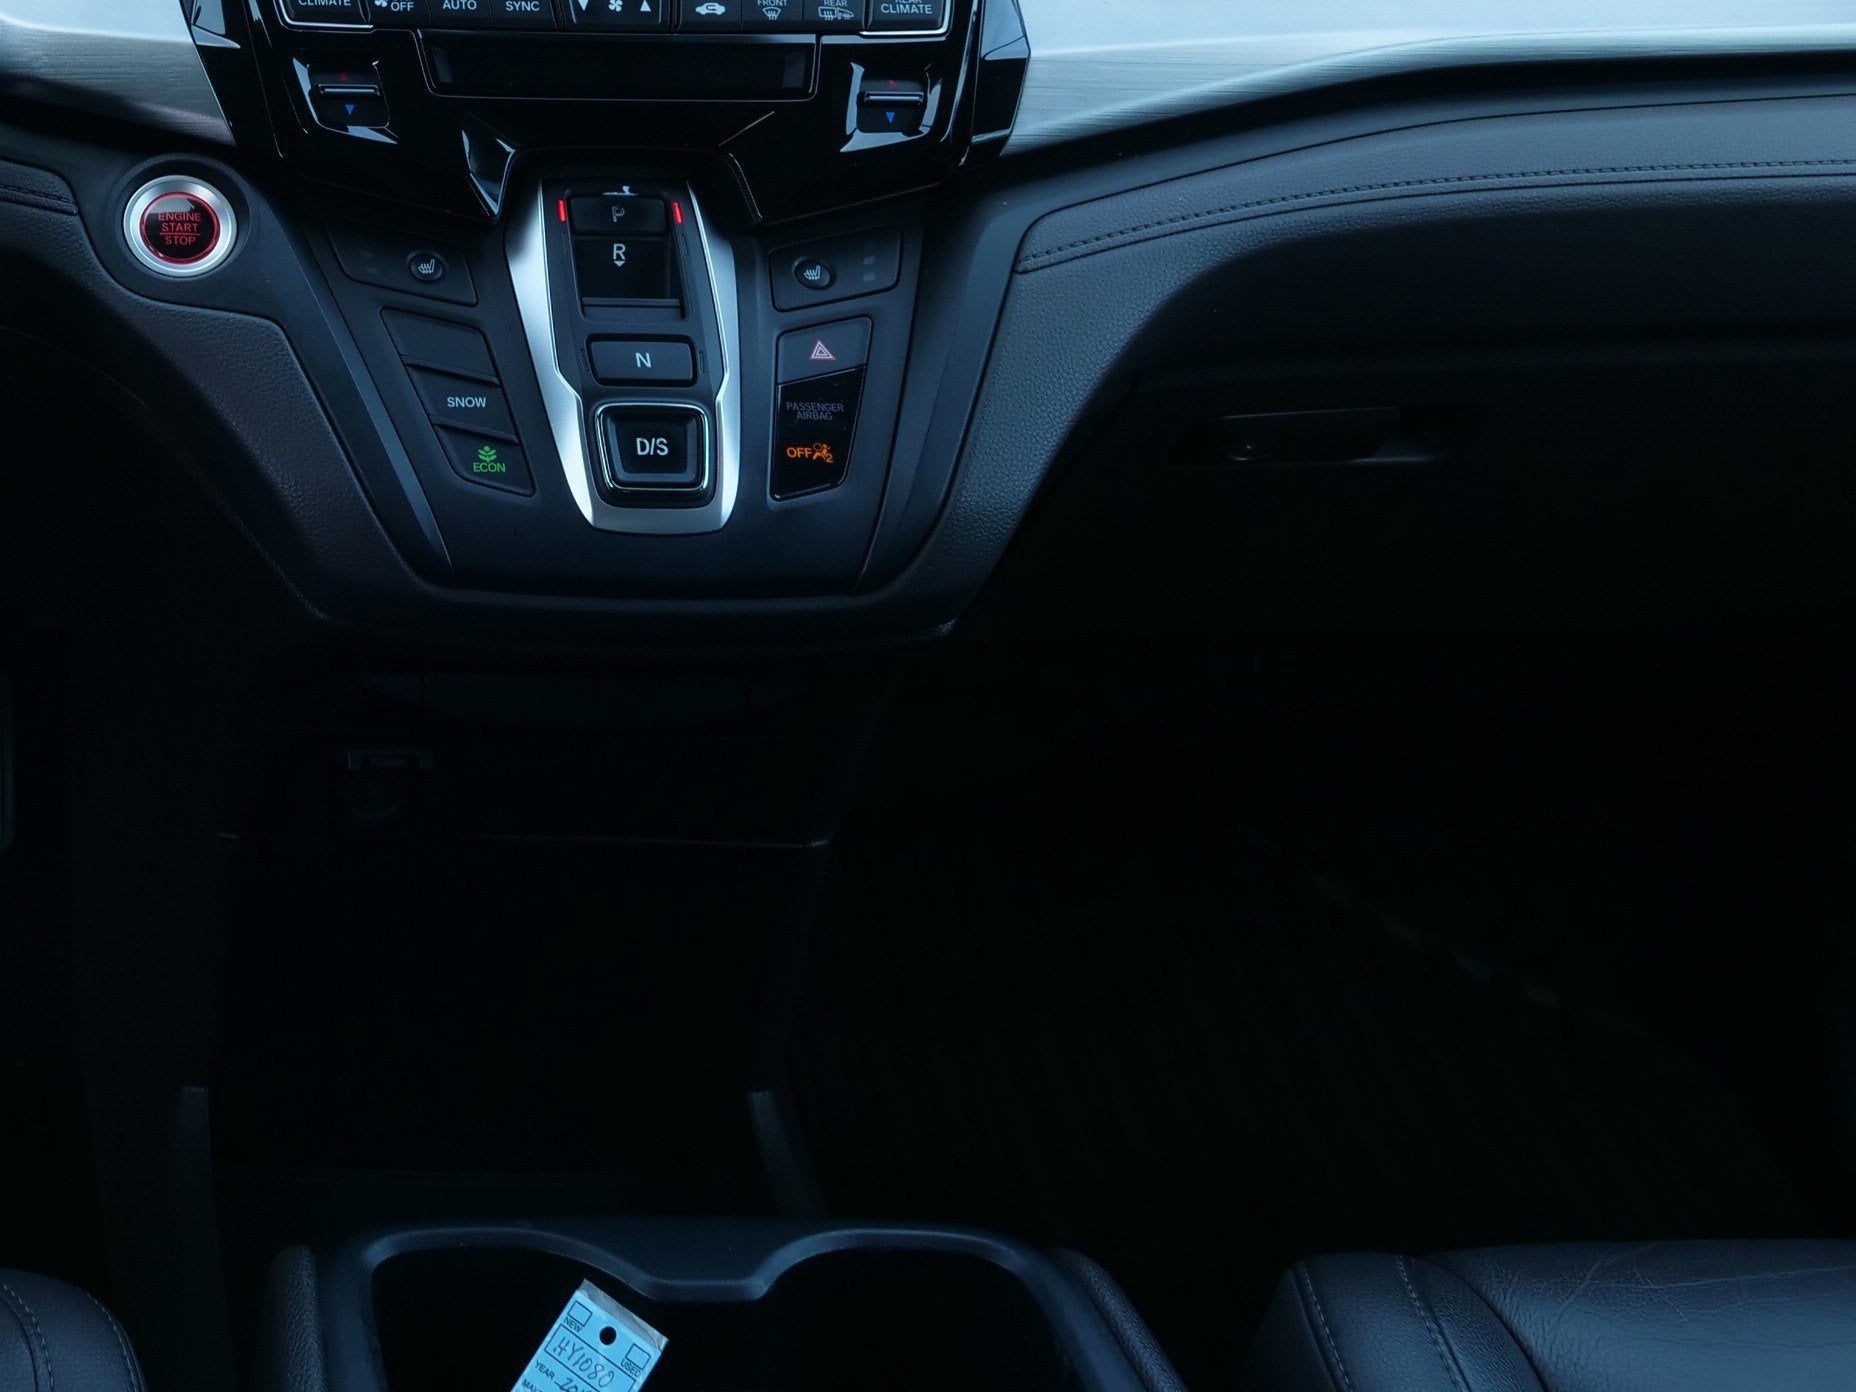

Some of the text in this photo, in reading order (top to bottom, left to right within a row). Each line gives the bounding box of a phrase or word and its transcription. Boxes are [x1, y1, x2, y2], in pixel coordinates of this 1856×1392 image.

[390, 1, 414, 11] OFF
[443, 0, 477, 10] AUTO
[505, 1, 540, 12] SYNC
[823, 0, 848, 7] REAR
[881, 4, 932, 14] CLIMATE
[158, 212, 202, 222] ENGINE
[611, 206, 625, 223] P
[161, 222, 199, 233] START
[165, 235, 196, 246] STOP
[612, 243, 626, 261] R
[635, 352, 652, 368] N
[446, 397, 487, 408] SNOW
[786, 401, 845, 412] PASSENGER
[796, 412, 833, 420] AIRBAG
[635, 437, 669, 457] D/S
[786, 447, 813, 458] OFF
[472, 462, 506, 473] ECON
[563, 1317, 583, 1333] NEW
[535, 1360, 555, 1381] YEAR
[620, 1359, 643, 1378] USED
